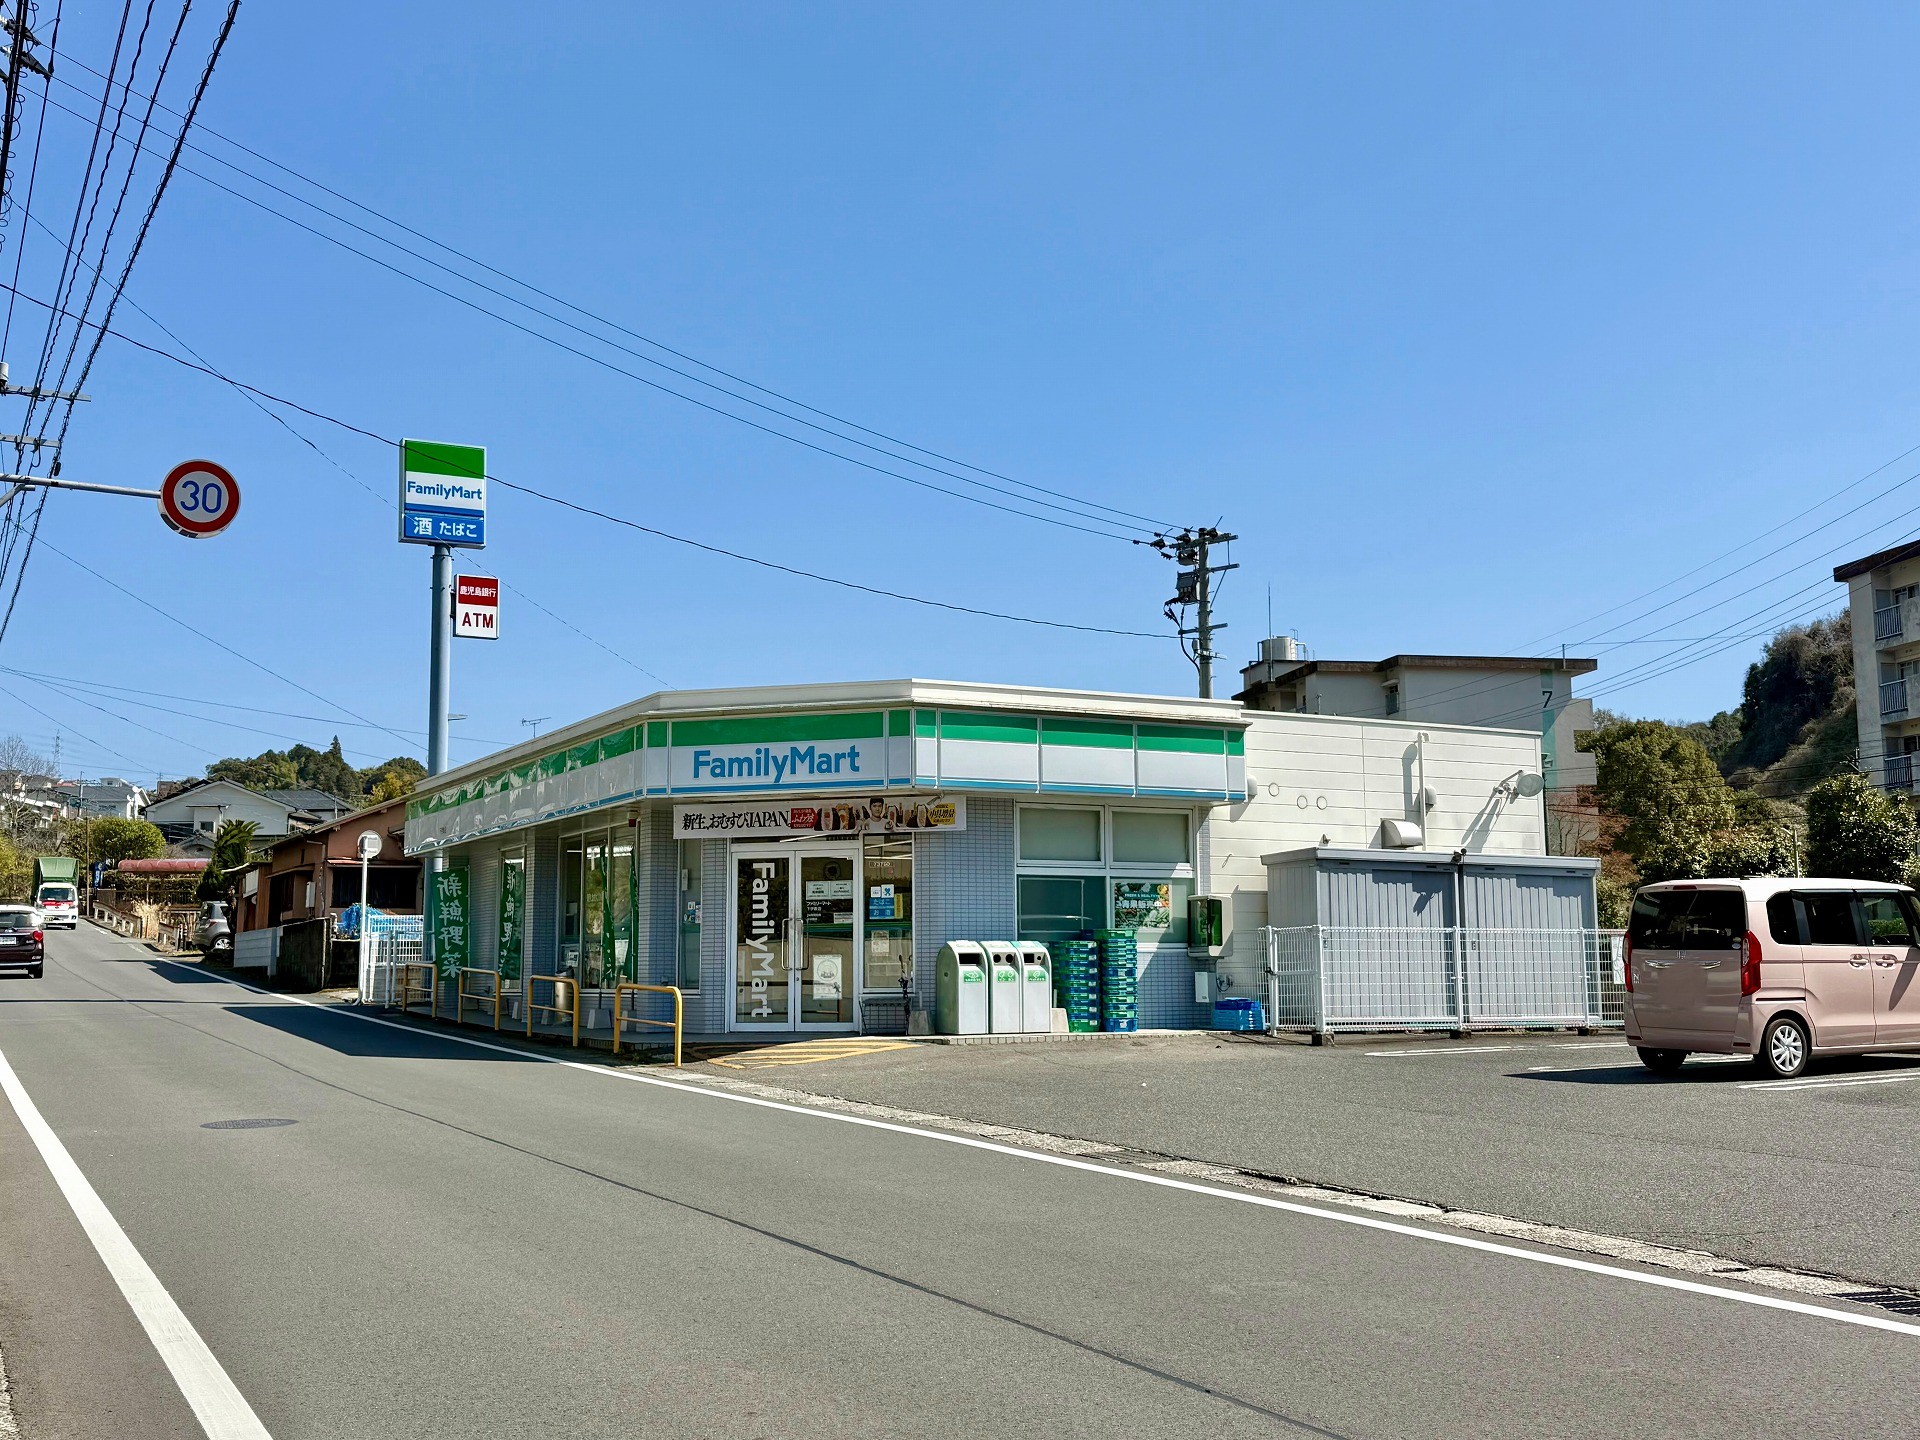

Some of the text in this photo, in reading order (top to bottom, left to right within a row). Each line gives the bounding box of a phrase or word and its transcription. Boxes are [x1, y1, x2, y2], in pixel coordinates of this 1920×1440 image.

[180, 480, 222, 514] 30
[407, 481, 482, 500] FamilyMart
[413, 516, 478, 538] 酒 たばこ
[459, 585, 497, 598] 鹿児島銀行
[461, 612, 493, 629] ATM
[1542, 691, 1553, 709] 7
[693, 745, 860, 784] FamilyMart
[873, 898, 891, 906] たばこ
[745, 862, 776, 1018] FamilyMart
